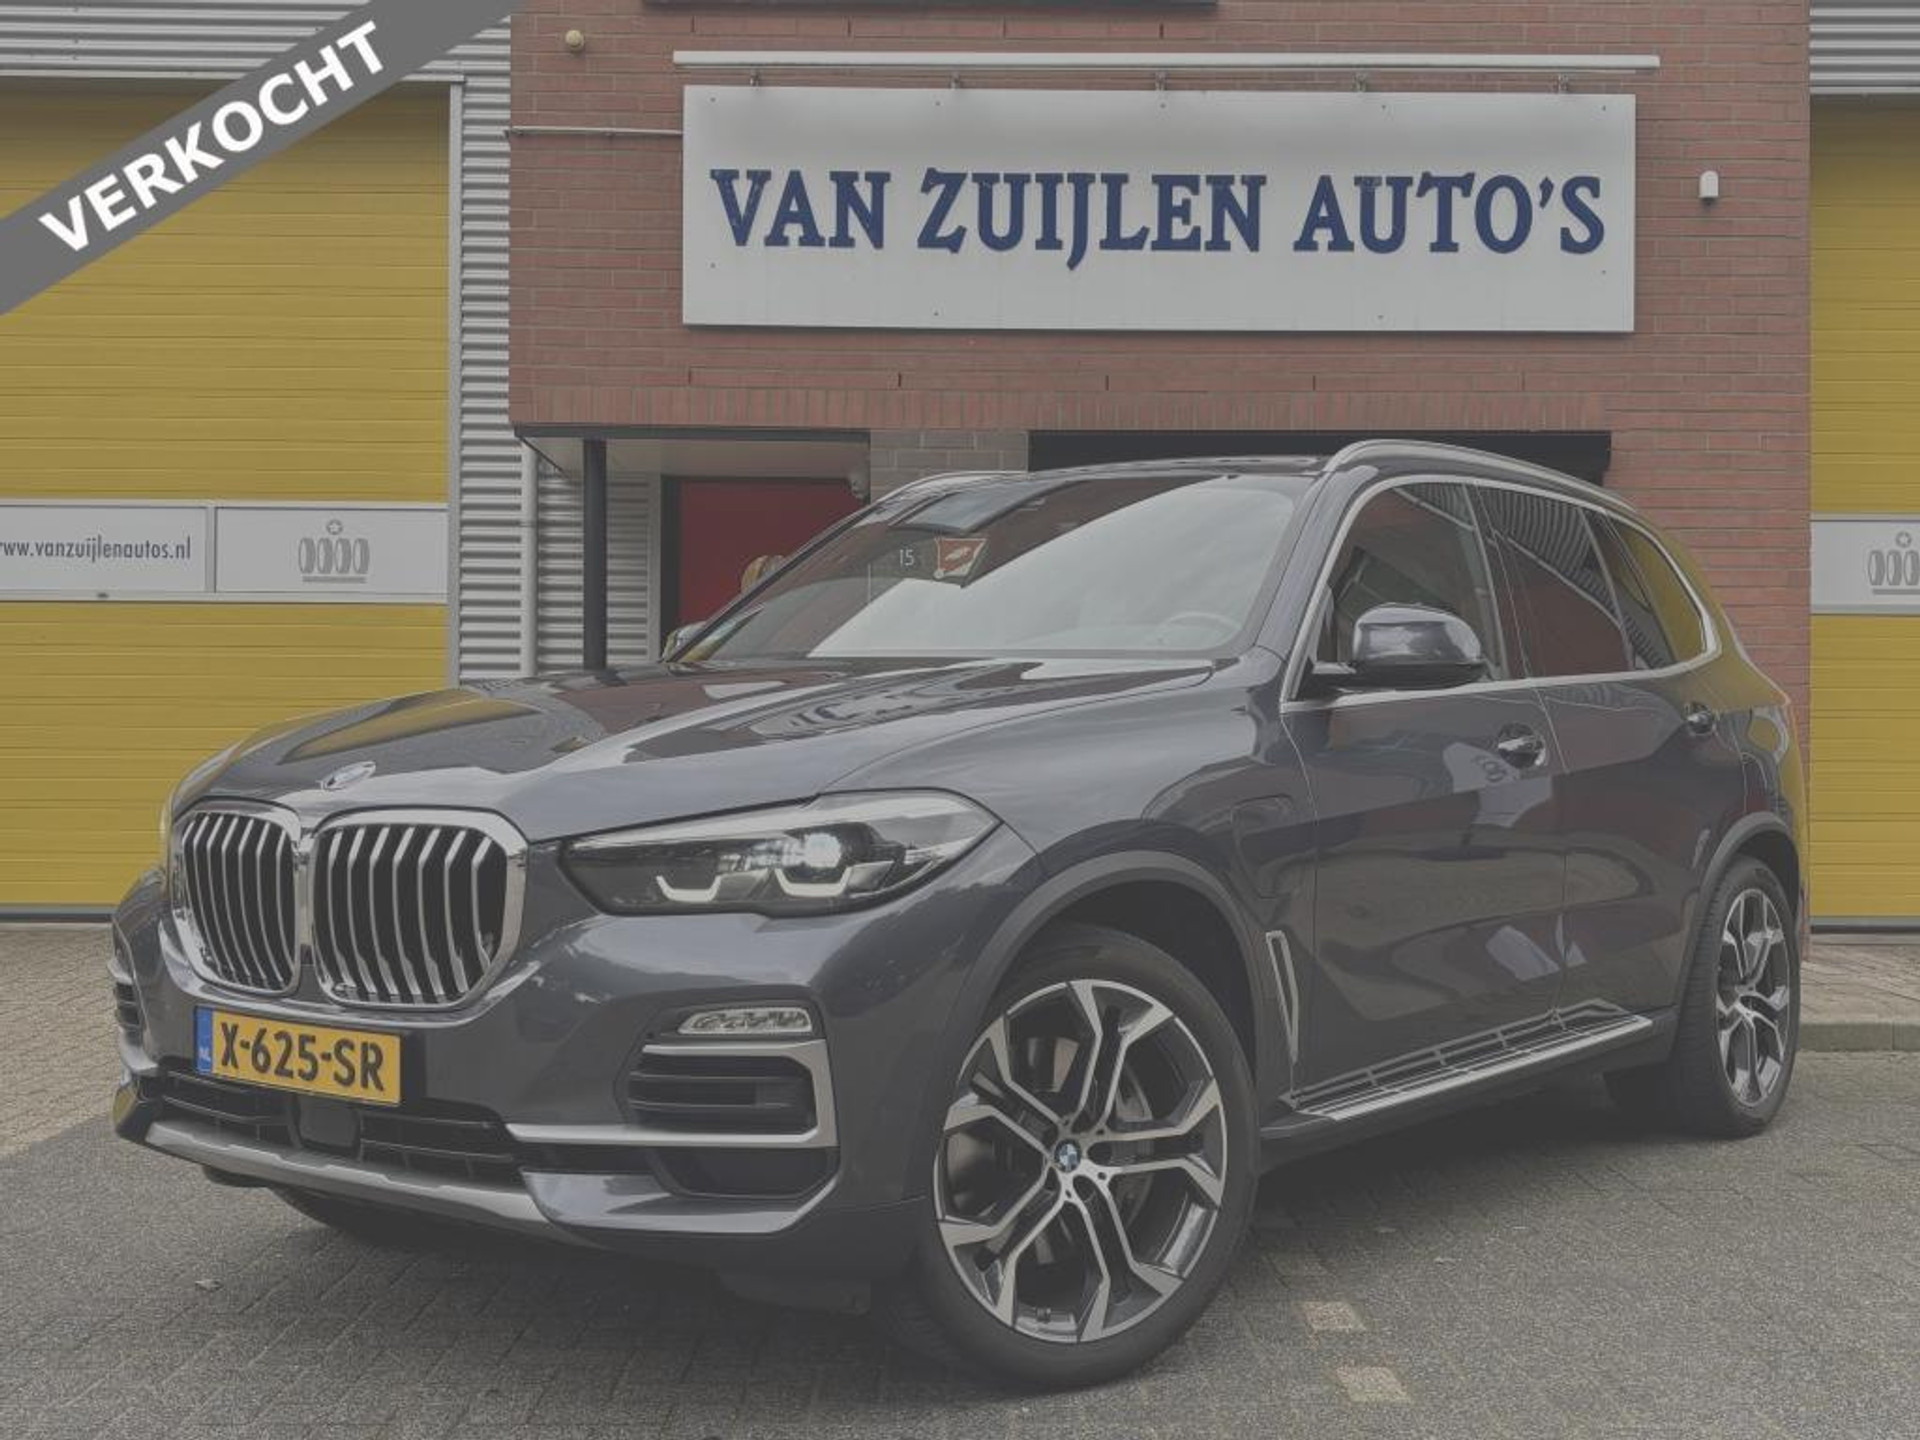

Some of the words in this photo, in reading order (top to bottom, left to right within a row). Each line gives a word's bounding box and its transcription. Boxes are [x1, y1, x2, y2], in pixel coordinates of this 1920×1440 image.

[710, 169, 891, 249] VAN
[917, 168, 1266, 270] ZUIJLEN
[1293, 172, 1606, 254] AUTO'S
[0, 534, 191, 563] ww.vanzuijlenautos.nl
[220, 1022, 384, 1091] X-625-SR
